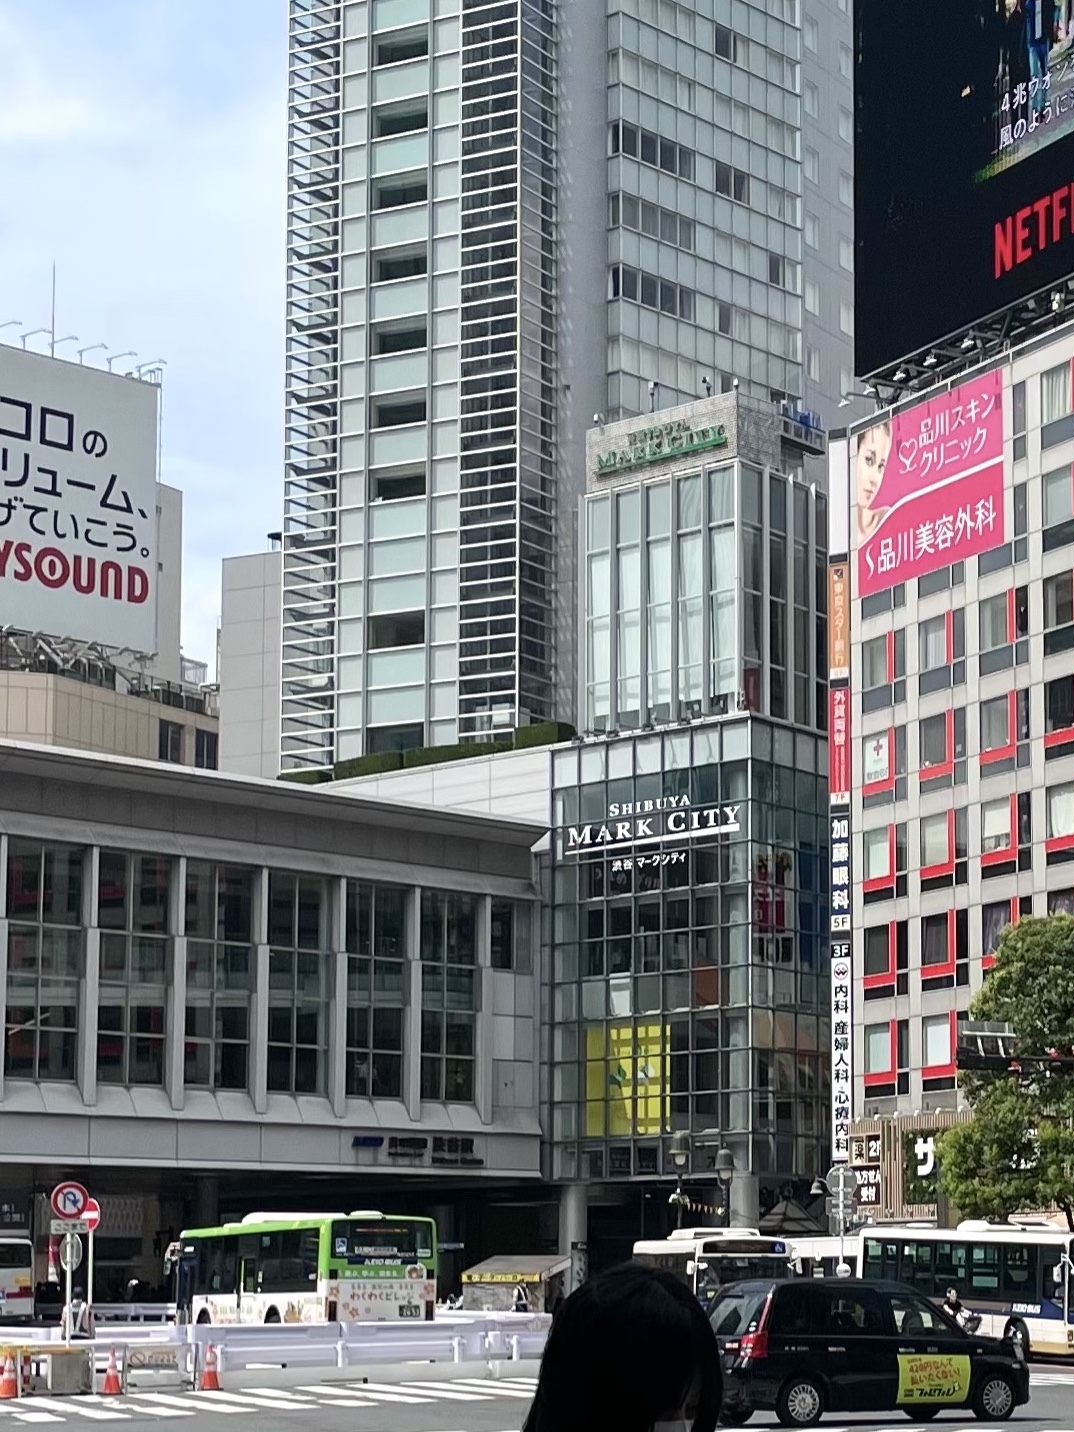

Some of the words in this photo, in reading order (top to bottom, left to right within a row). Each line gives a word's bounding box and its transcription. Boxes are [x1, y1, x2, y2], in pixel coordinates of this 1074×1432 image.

[919, 393, 996, 449] 品川スキン
[920, 427, 987, 478] クリニック
[877, 496, 997, 574] 品川美容外科
[609, 794, 691, 817] SHIBUYA
[568, 819, 653, 847] MARK
[667, 805, 740, 833] CITY
[832, 819, 849, 910] 加藤眼科
[834, 917, 848, 928] 5F
[834, 945, 849, 957] 3F
[834, 984, 848, 1013] 内科
[860, 1186, 876, 1202] 受付
